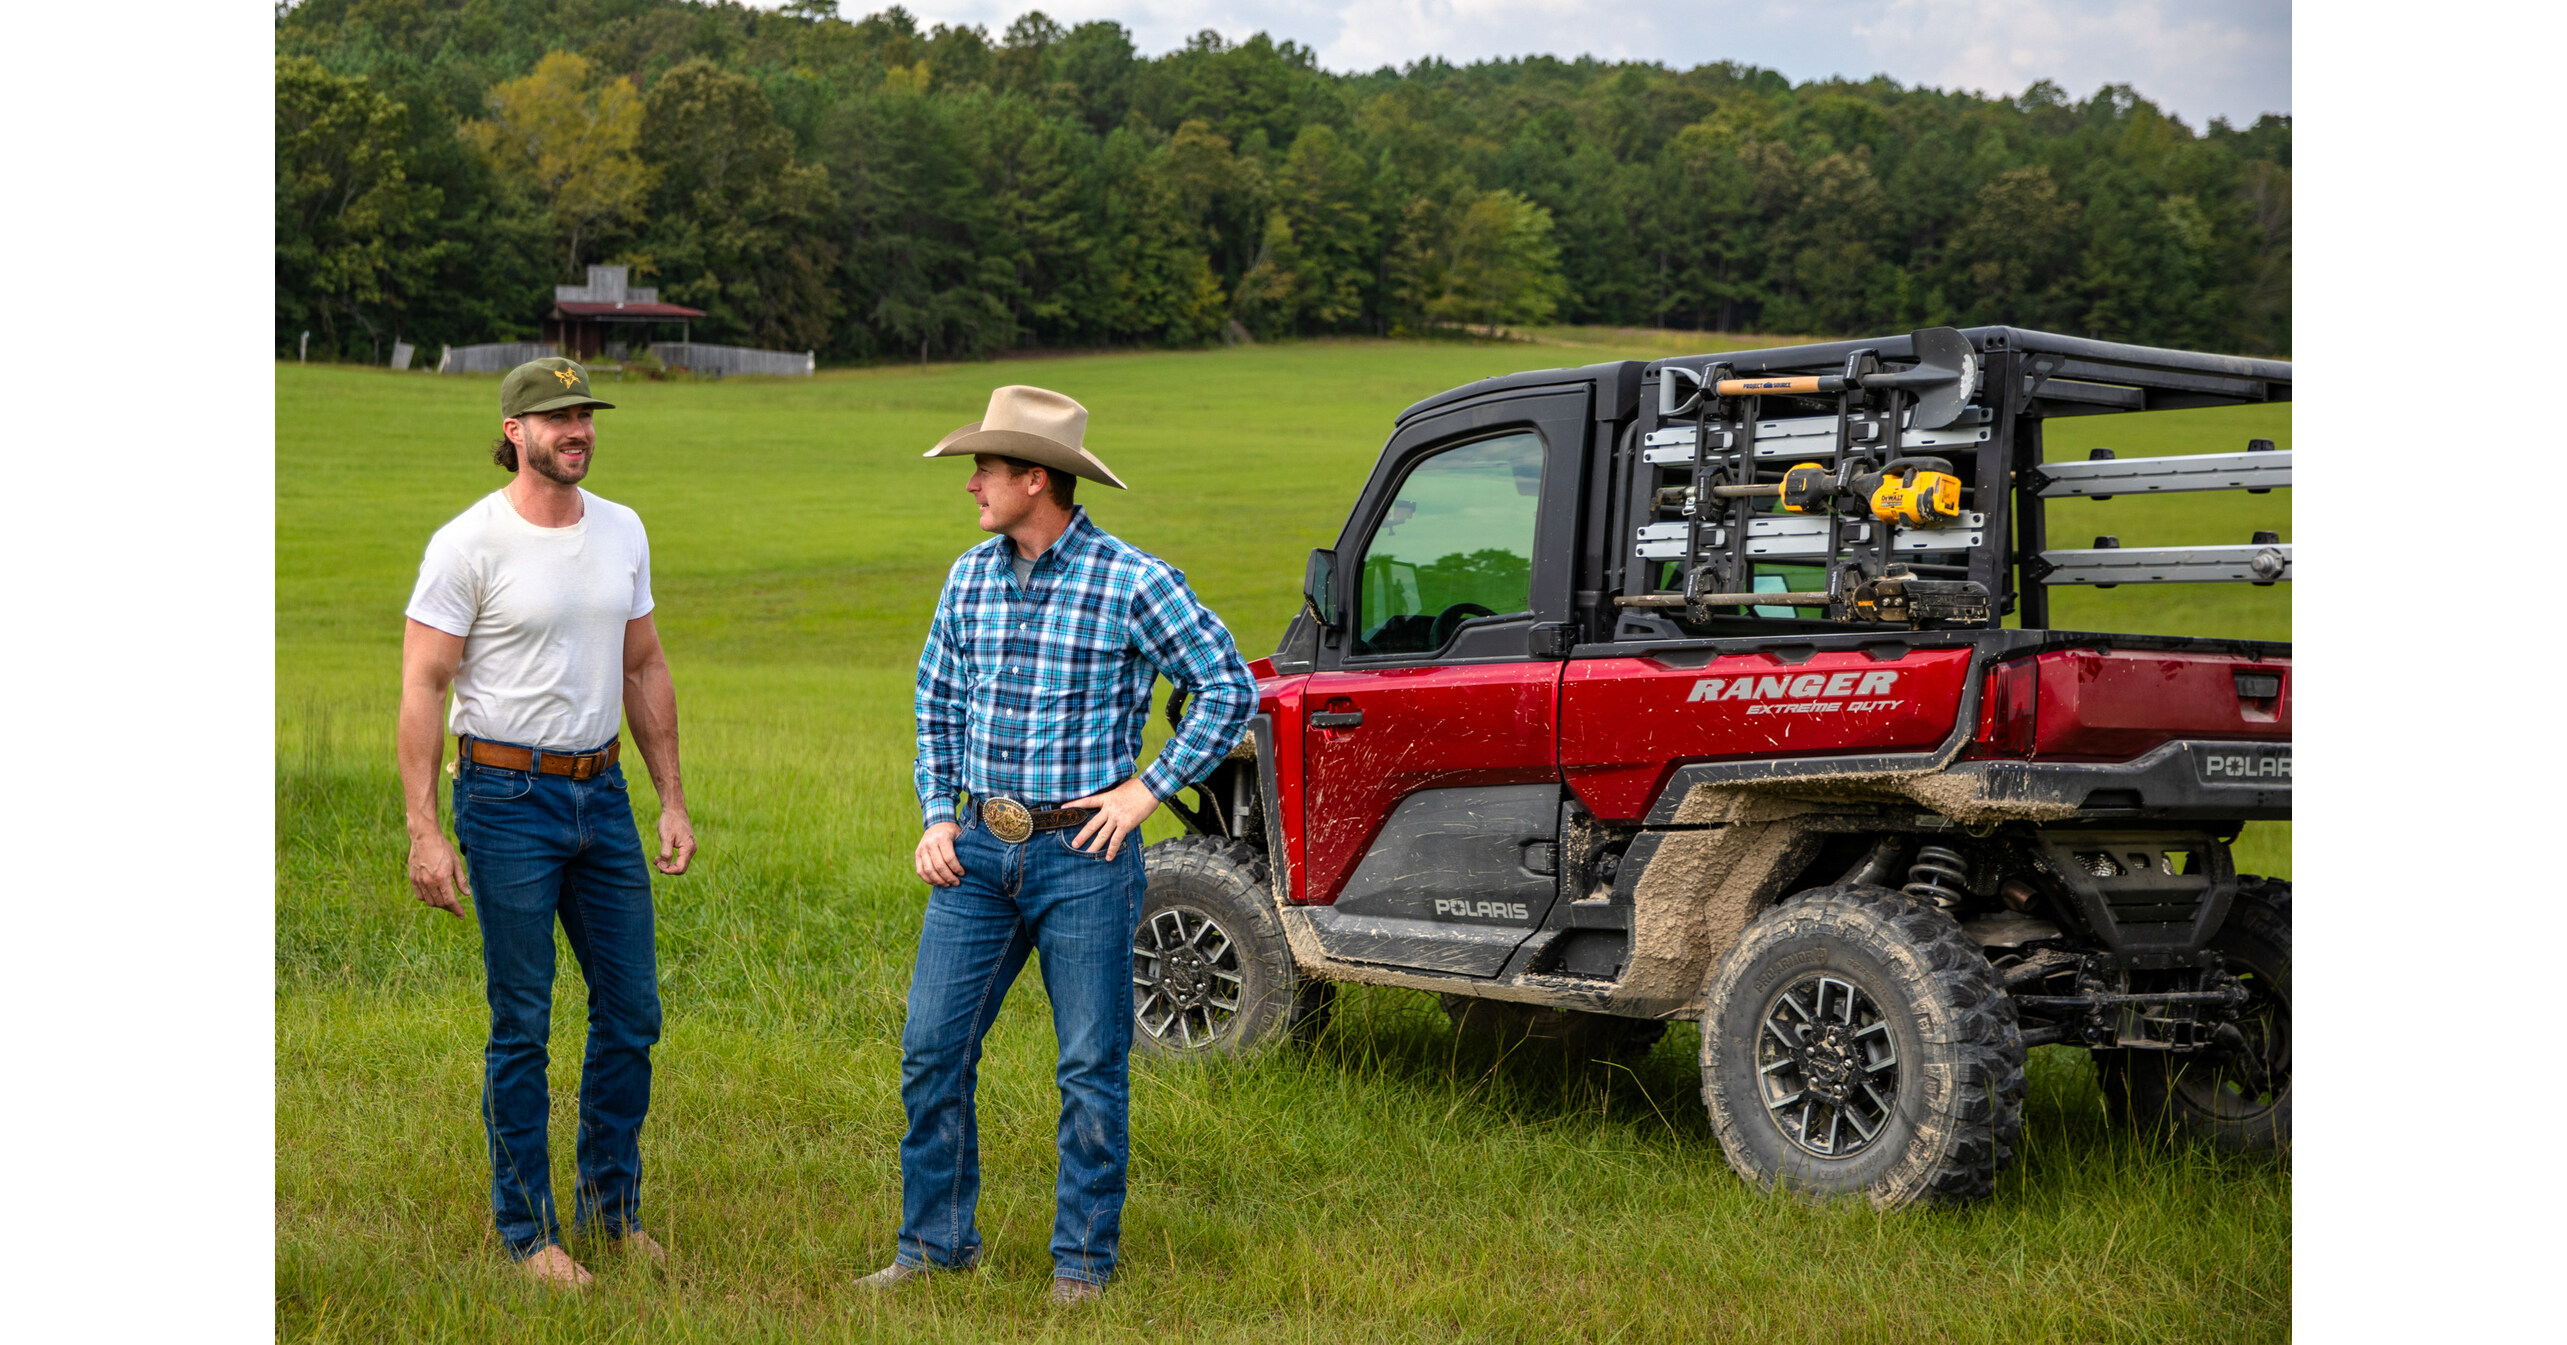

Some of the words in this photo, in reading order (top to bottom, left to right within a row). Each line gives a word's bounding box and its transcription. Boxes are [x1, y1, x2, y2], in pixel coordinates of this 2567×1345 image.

[1686, 670, 1899, 703] RANGER
[1746, 701, 1843, 715] EXTREME
[1846, 700, 1904, 712] DUTY
[2206, 756, 2292, 777] POLAR
[1434, 899, 1529, 920] POLARIS
